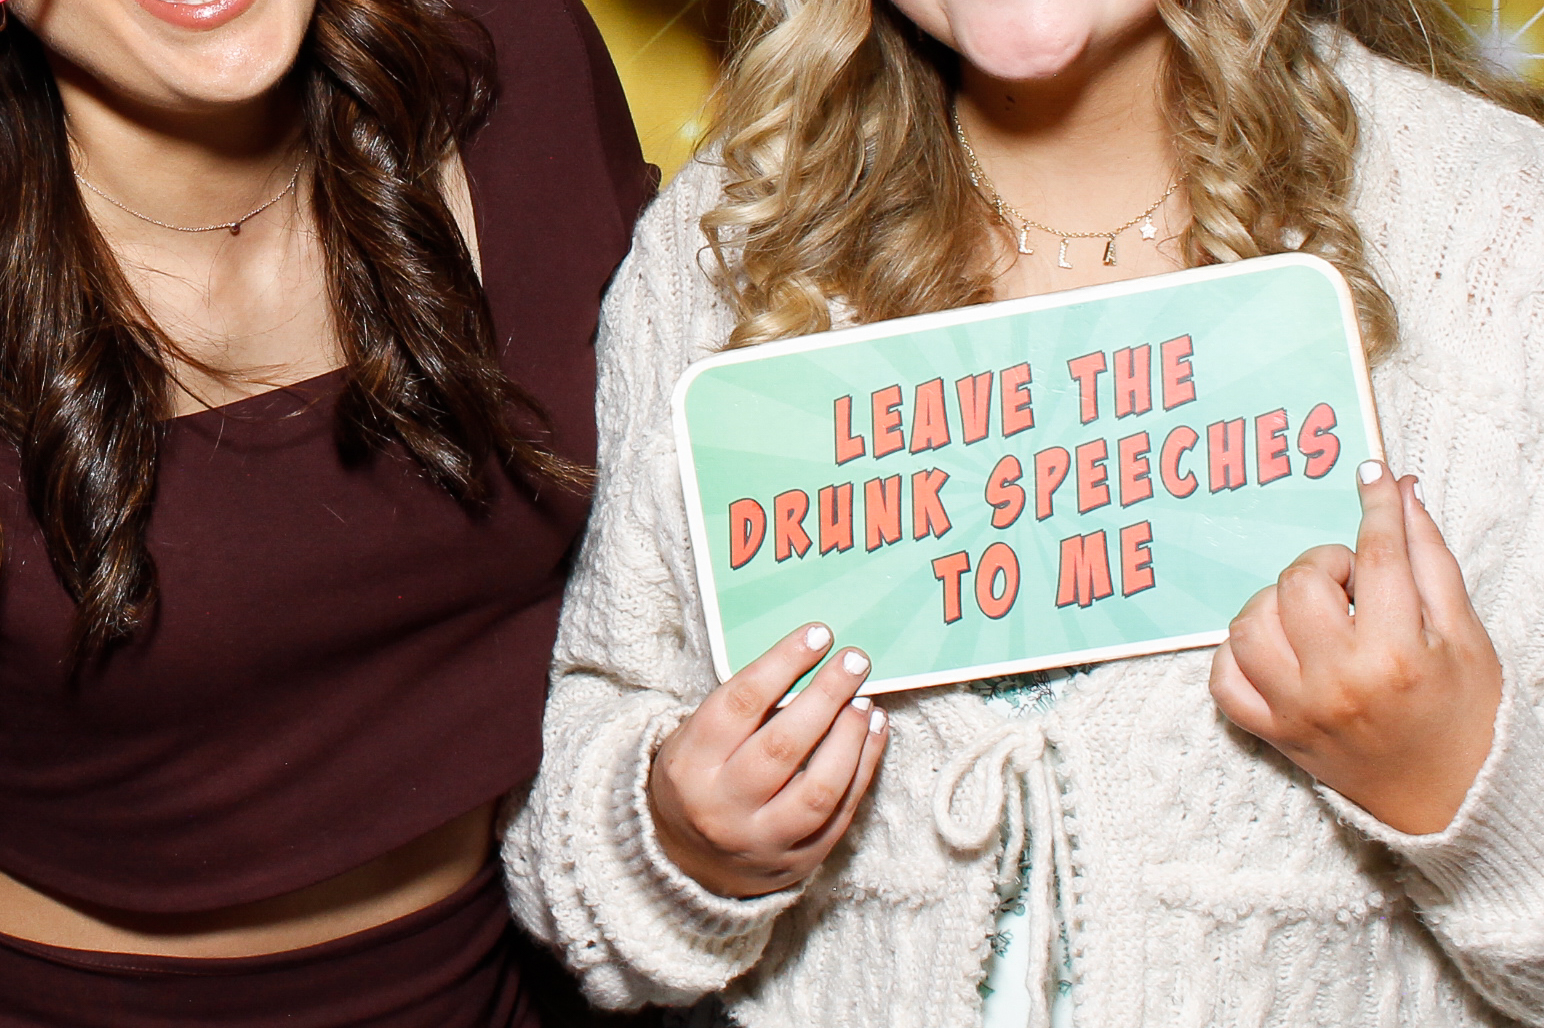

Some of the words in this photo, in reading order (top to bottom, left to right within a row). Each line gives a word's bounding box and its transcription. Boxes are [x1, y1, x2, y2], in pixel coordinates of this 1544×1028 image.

[833, 361, 1036, 465] LEAVE
[1068, 333, 1196, 425] THE
[728, 468, 952, 570] DRUNK
[985, 402, 1341, 530] SPEECHES
[931, 541, 1020, 625] TO
[1055, 520, 1156, 609] ME
